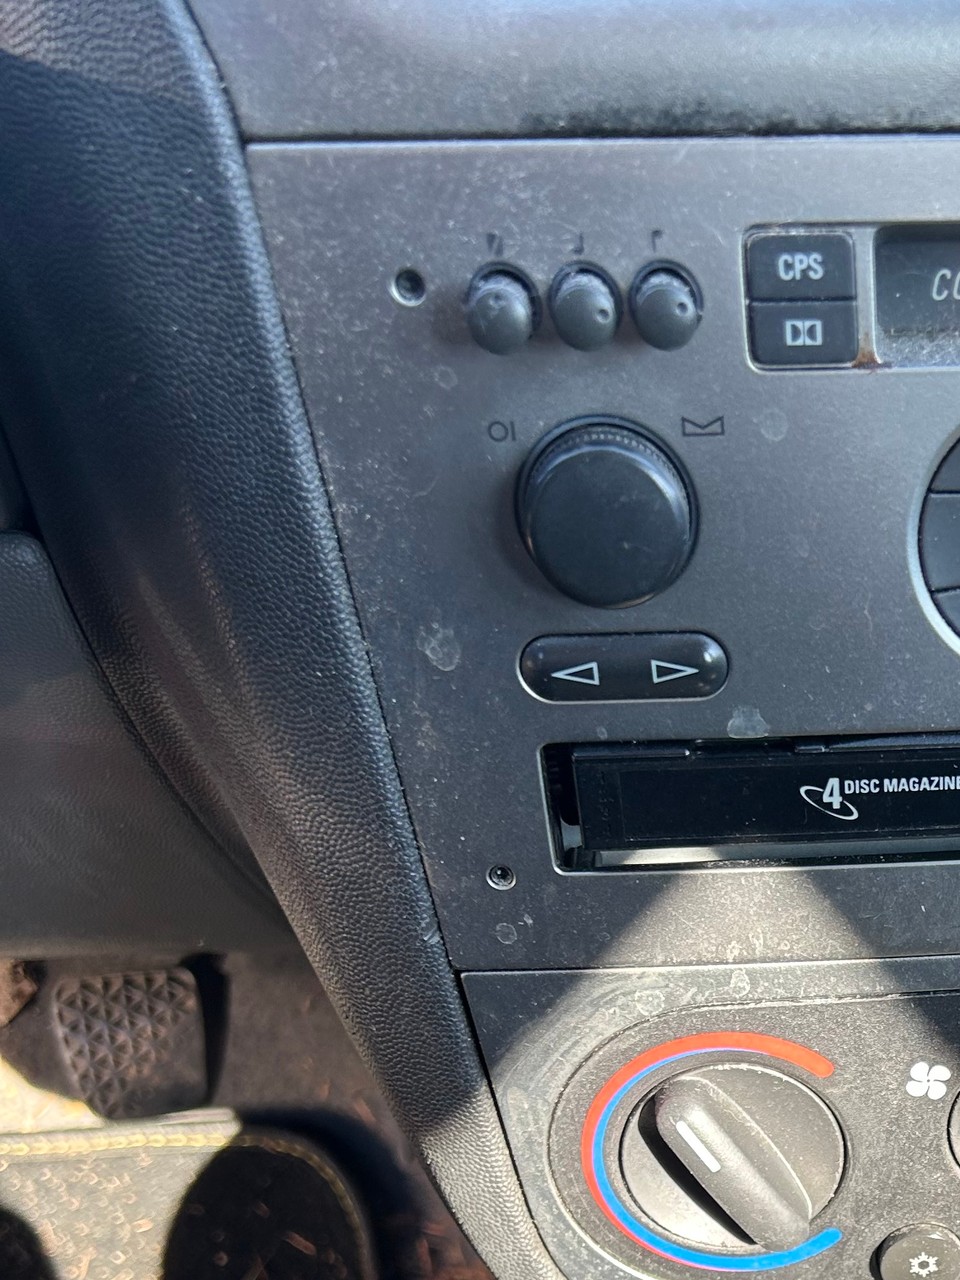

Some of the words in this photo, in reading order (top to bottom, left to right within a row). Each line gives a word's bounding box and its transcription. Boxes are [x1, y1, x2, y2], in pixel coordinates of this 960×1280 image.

[777, 252, 824, 282] CPS
[822, 777, 843, 810] 4
[844, 779, 880, 795] DISC
